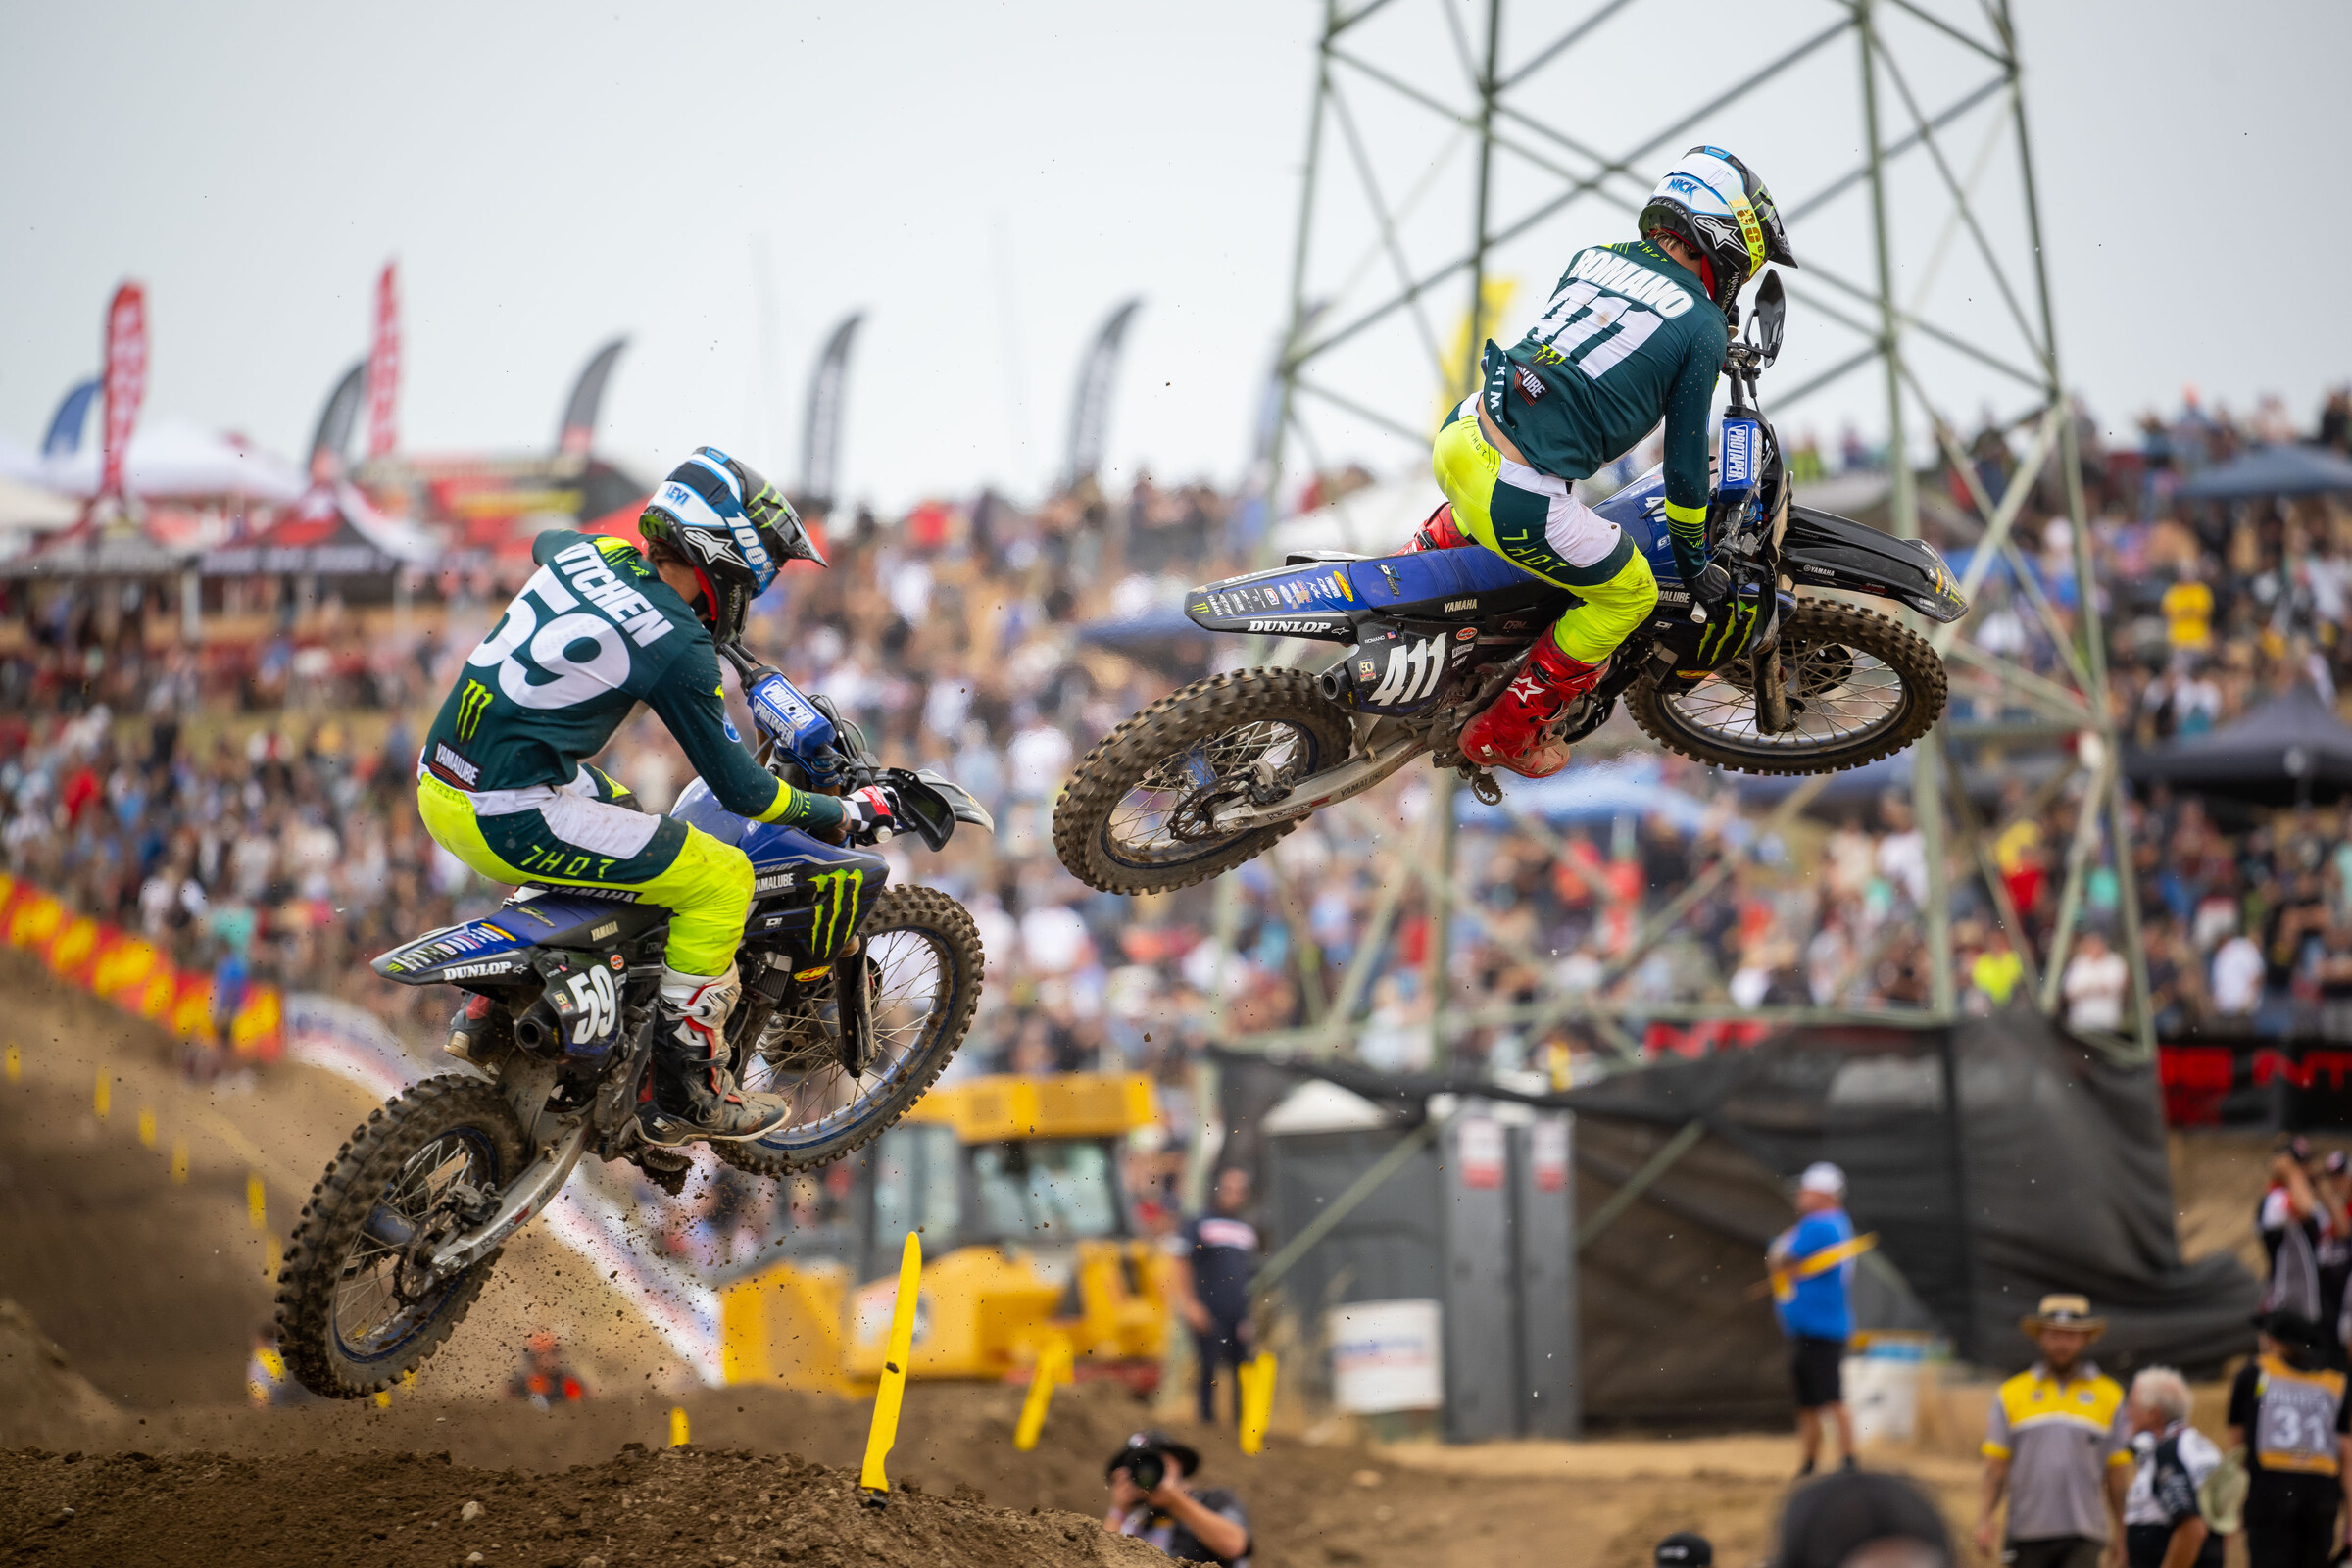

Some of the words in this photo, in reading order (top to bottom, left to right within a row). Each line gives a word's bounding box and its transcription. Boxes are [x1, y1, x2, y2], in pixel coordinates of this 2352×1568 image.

[1666, 178, 1700, 205] NICK
[1568, 248, 1694, 319] ROMANO
[1533, 279, 1664, 380] 411
[1731, 427, 1745, 479] PROTAPER
[663, 484, 690, 507] LEVI
[1811, 565, 1836, 577] YAMAHA
[1206, 594, 1224, 617] YAMAHA
[1444, 597, 1478, 613] YAMAHA
[1658, 590, 1690, 604] MALUBE
[466, 563, 632, 710] 59
[1247, 620, 1332, 634] DUNLOP
[1360, 661, 1373, 673] 50
[1367, 631, 1447, 707] 411
[764, 682, 815, 728] PROTAPER
[755, 698, 795, 749] PROTAPER
[435, 742, 480, 787] YAMALUBE
[1340, 767, 1386, 798] YAMALUBE
[551, 885, 637, 904] YAMAHA
[756, 872, 795, 894] AMALUBE
[590, 920, 619, 943] YAMAHA
[442, 960, 513, 982] DUNLOP
[565, 963, 617, 1045] 59
[2270, 1404, 2328, 1452] 31
